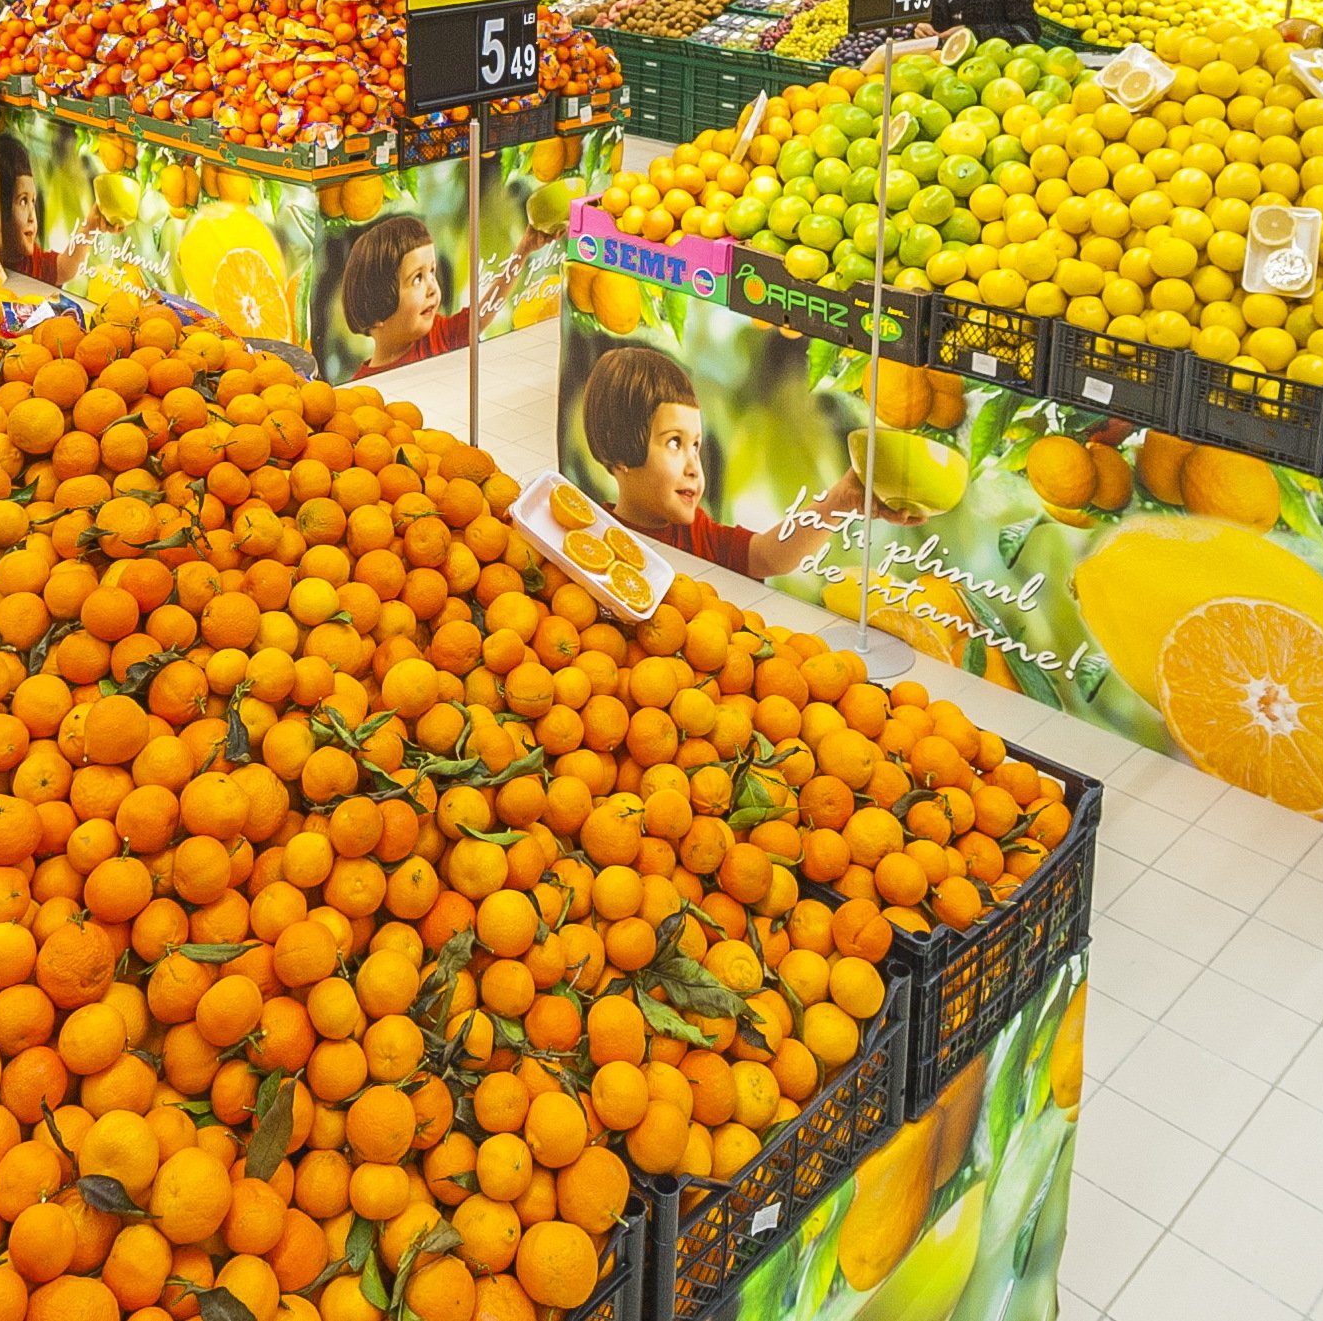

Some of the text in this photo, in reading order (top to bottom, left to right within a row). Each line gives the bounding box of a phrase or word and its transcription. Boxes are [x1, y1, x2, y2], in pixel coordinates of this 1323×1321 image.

[523, 12, 536, 25] LEI
[481, 18, 536, 84] 5 49
[78, 252, 98, 278] de
[604, 238, 687, 286] SEMT
[479, 286, 505, 317] de
[798, 542, 845, 584] de
[877, 534, 1046, 612] plinul
